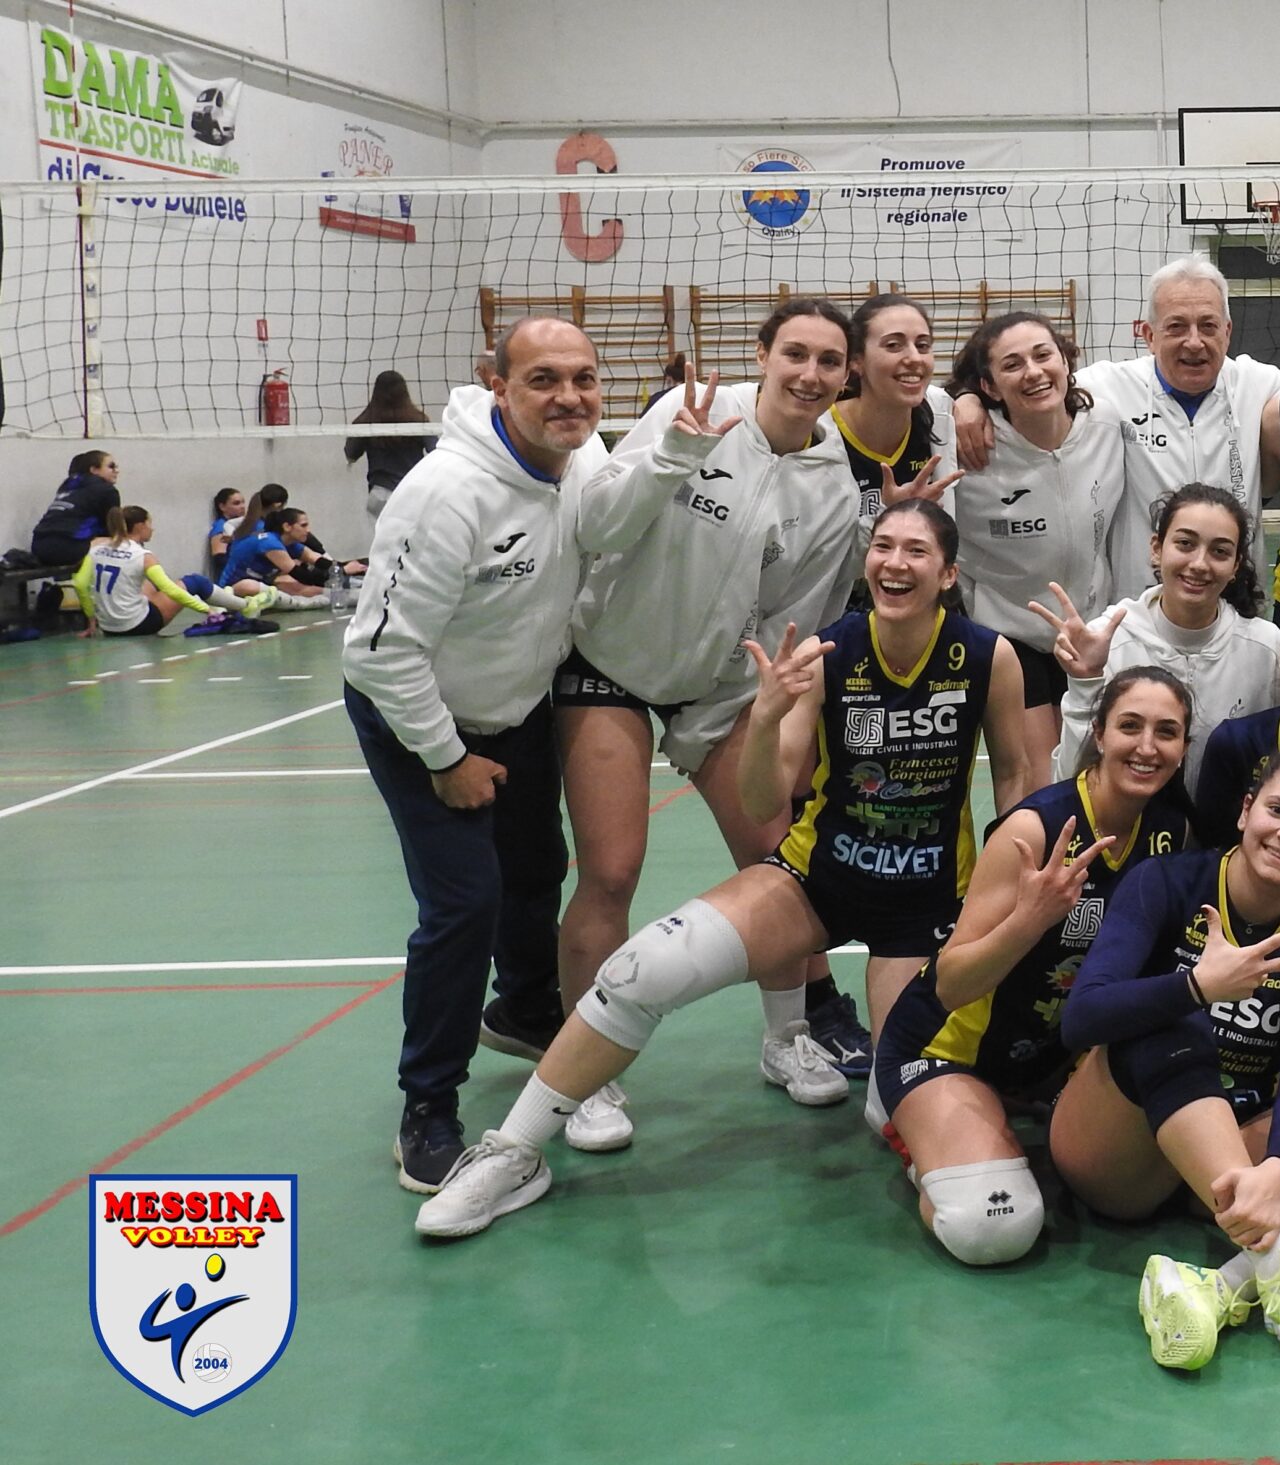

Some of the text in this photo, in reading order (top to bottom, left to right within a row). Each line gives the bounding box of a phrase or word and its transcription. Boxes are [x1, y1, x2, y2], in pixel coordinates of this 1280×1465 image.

[41, 29, 184, 128] DAMA
[44, 100, 186, 164] TRASPORTI
[881, 158, 966, 171] Promuove
[886, 209, 968, 226] regionale
[691, 494, 731, 521] ESG
[1011, 518, 1047, 534] ESG
[96, 563, 120, 595] 17
[948, 642, 966, 671] 9
[928, 678, 971, 692] Tradimalt
[888, 705, 958, 739] ESG
[877, 744, 902, 753] CIVILI
[912, 740, 957, 750] INDUSTRIALI
[832, 833, 944, 875] SICILVET
[1149, 831, 1172, 856] 16
[1060, 938, 1089, 948] PULIZIE
[1218, 1026, 1278, 1047] E INDUSTRIALI
[987, 1206, 1014, 1217] errea
